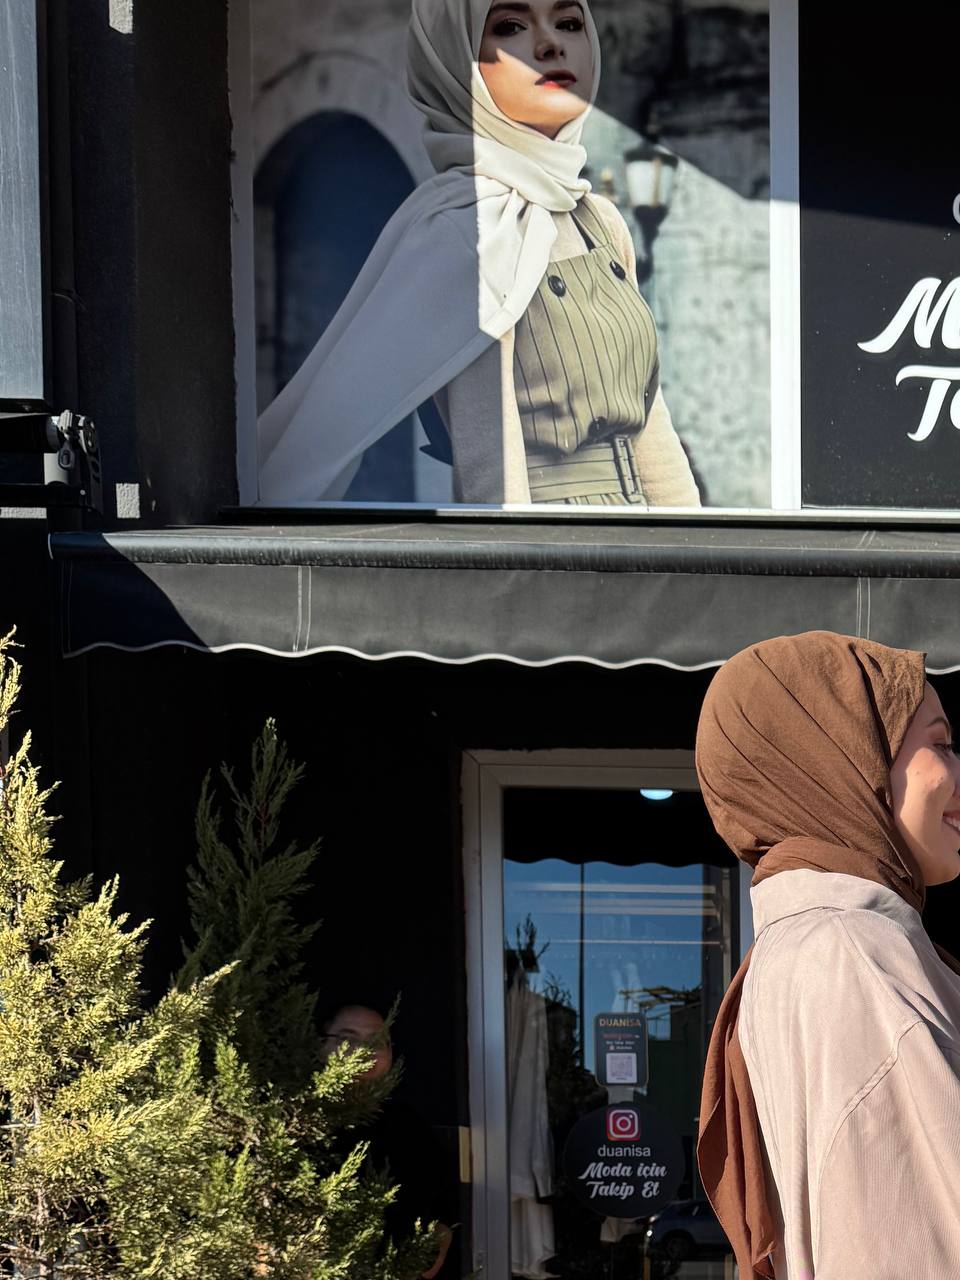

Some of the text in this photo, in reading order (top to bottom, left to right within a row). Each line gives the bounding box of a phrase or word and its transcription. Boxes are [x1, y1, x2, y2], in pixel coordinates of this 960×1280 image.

[597, 1144, 651, 1157] duanisa
[578, 1162, 667, 1179] Moda için
[586, 1180, 660, 1199] Takip Et
